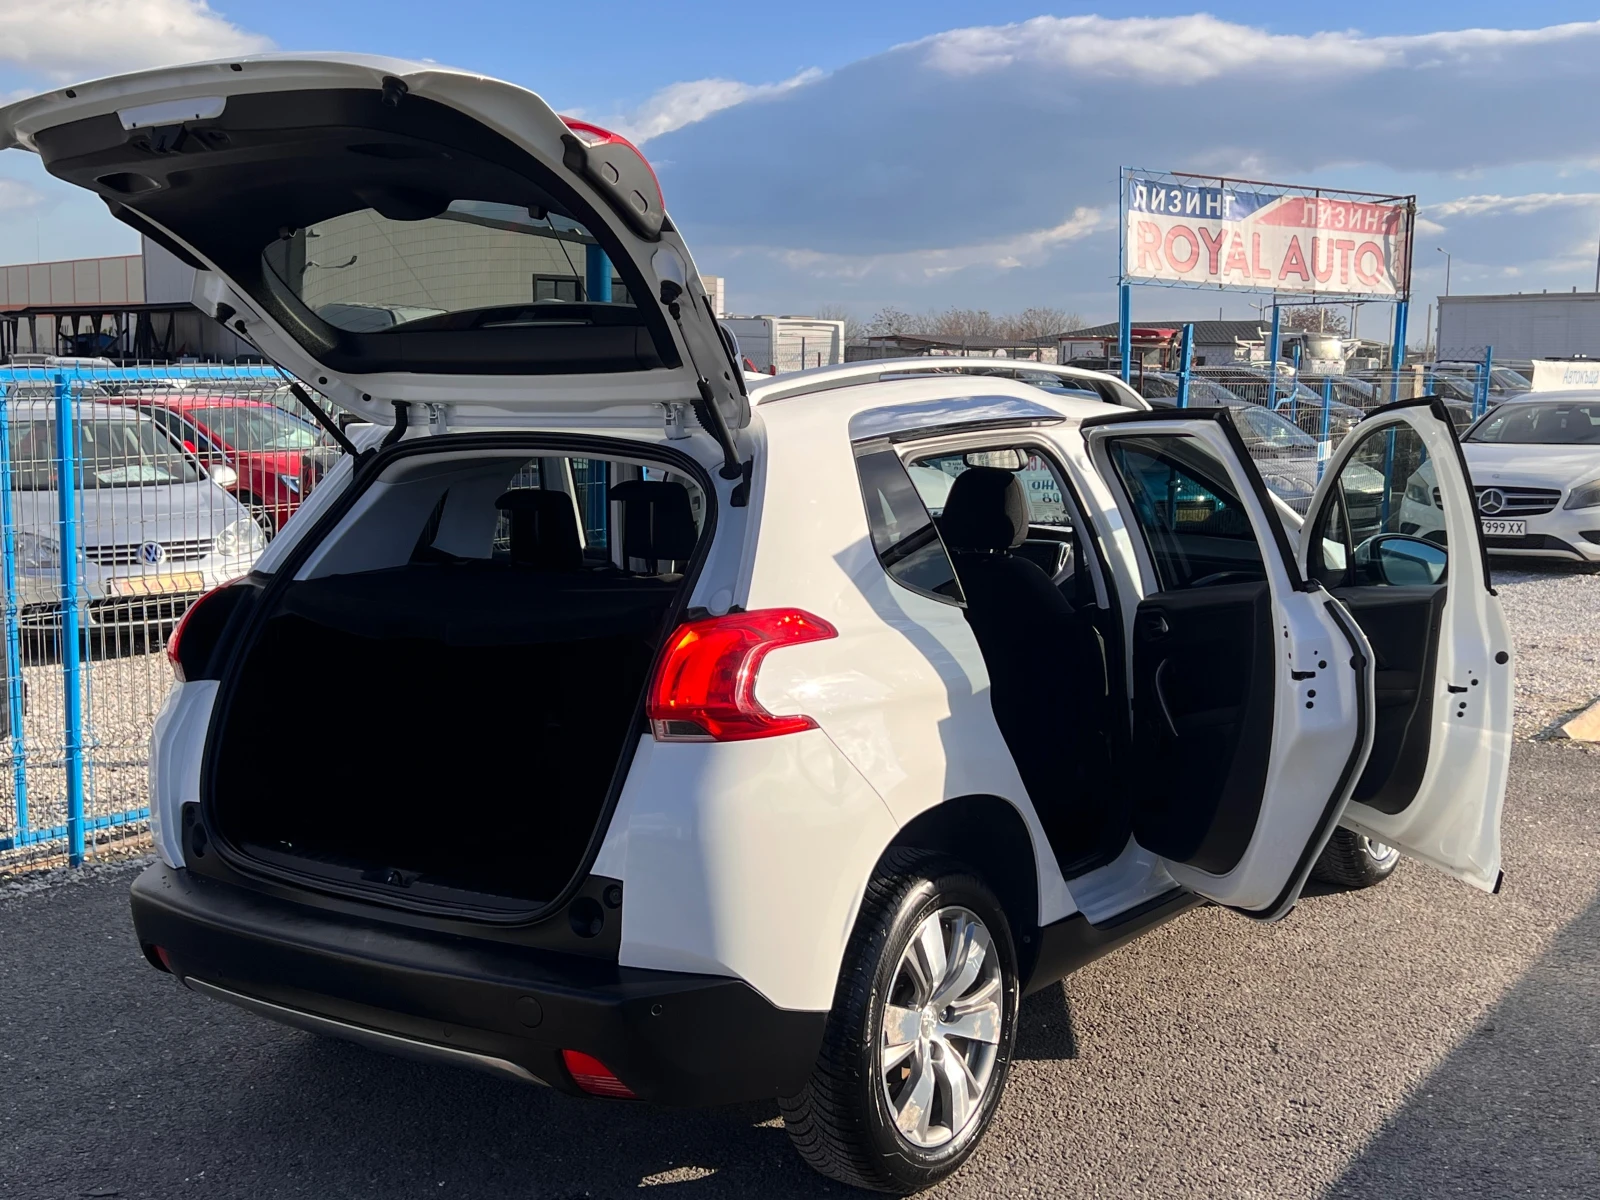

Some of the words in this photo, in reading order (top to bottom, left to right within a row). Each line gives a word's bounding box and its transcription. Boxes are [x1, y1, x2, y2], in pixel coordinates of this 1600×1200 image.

[1133, 185, 1236, 217] ЛИЗИНГ
[1301, 203, 1391, 231] ЛИЗИНГ
[1137, 221, 1271, 279] ROYAL
[1278, 235, 1385, 286] AUTO
